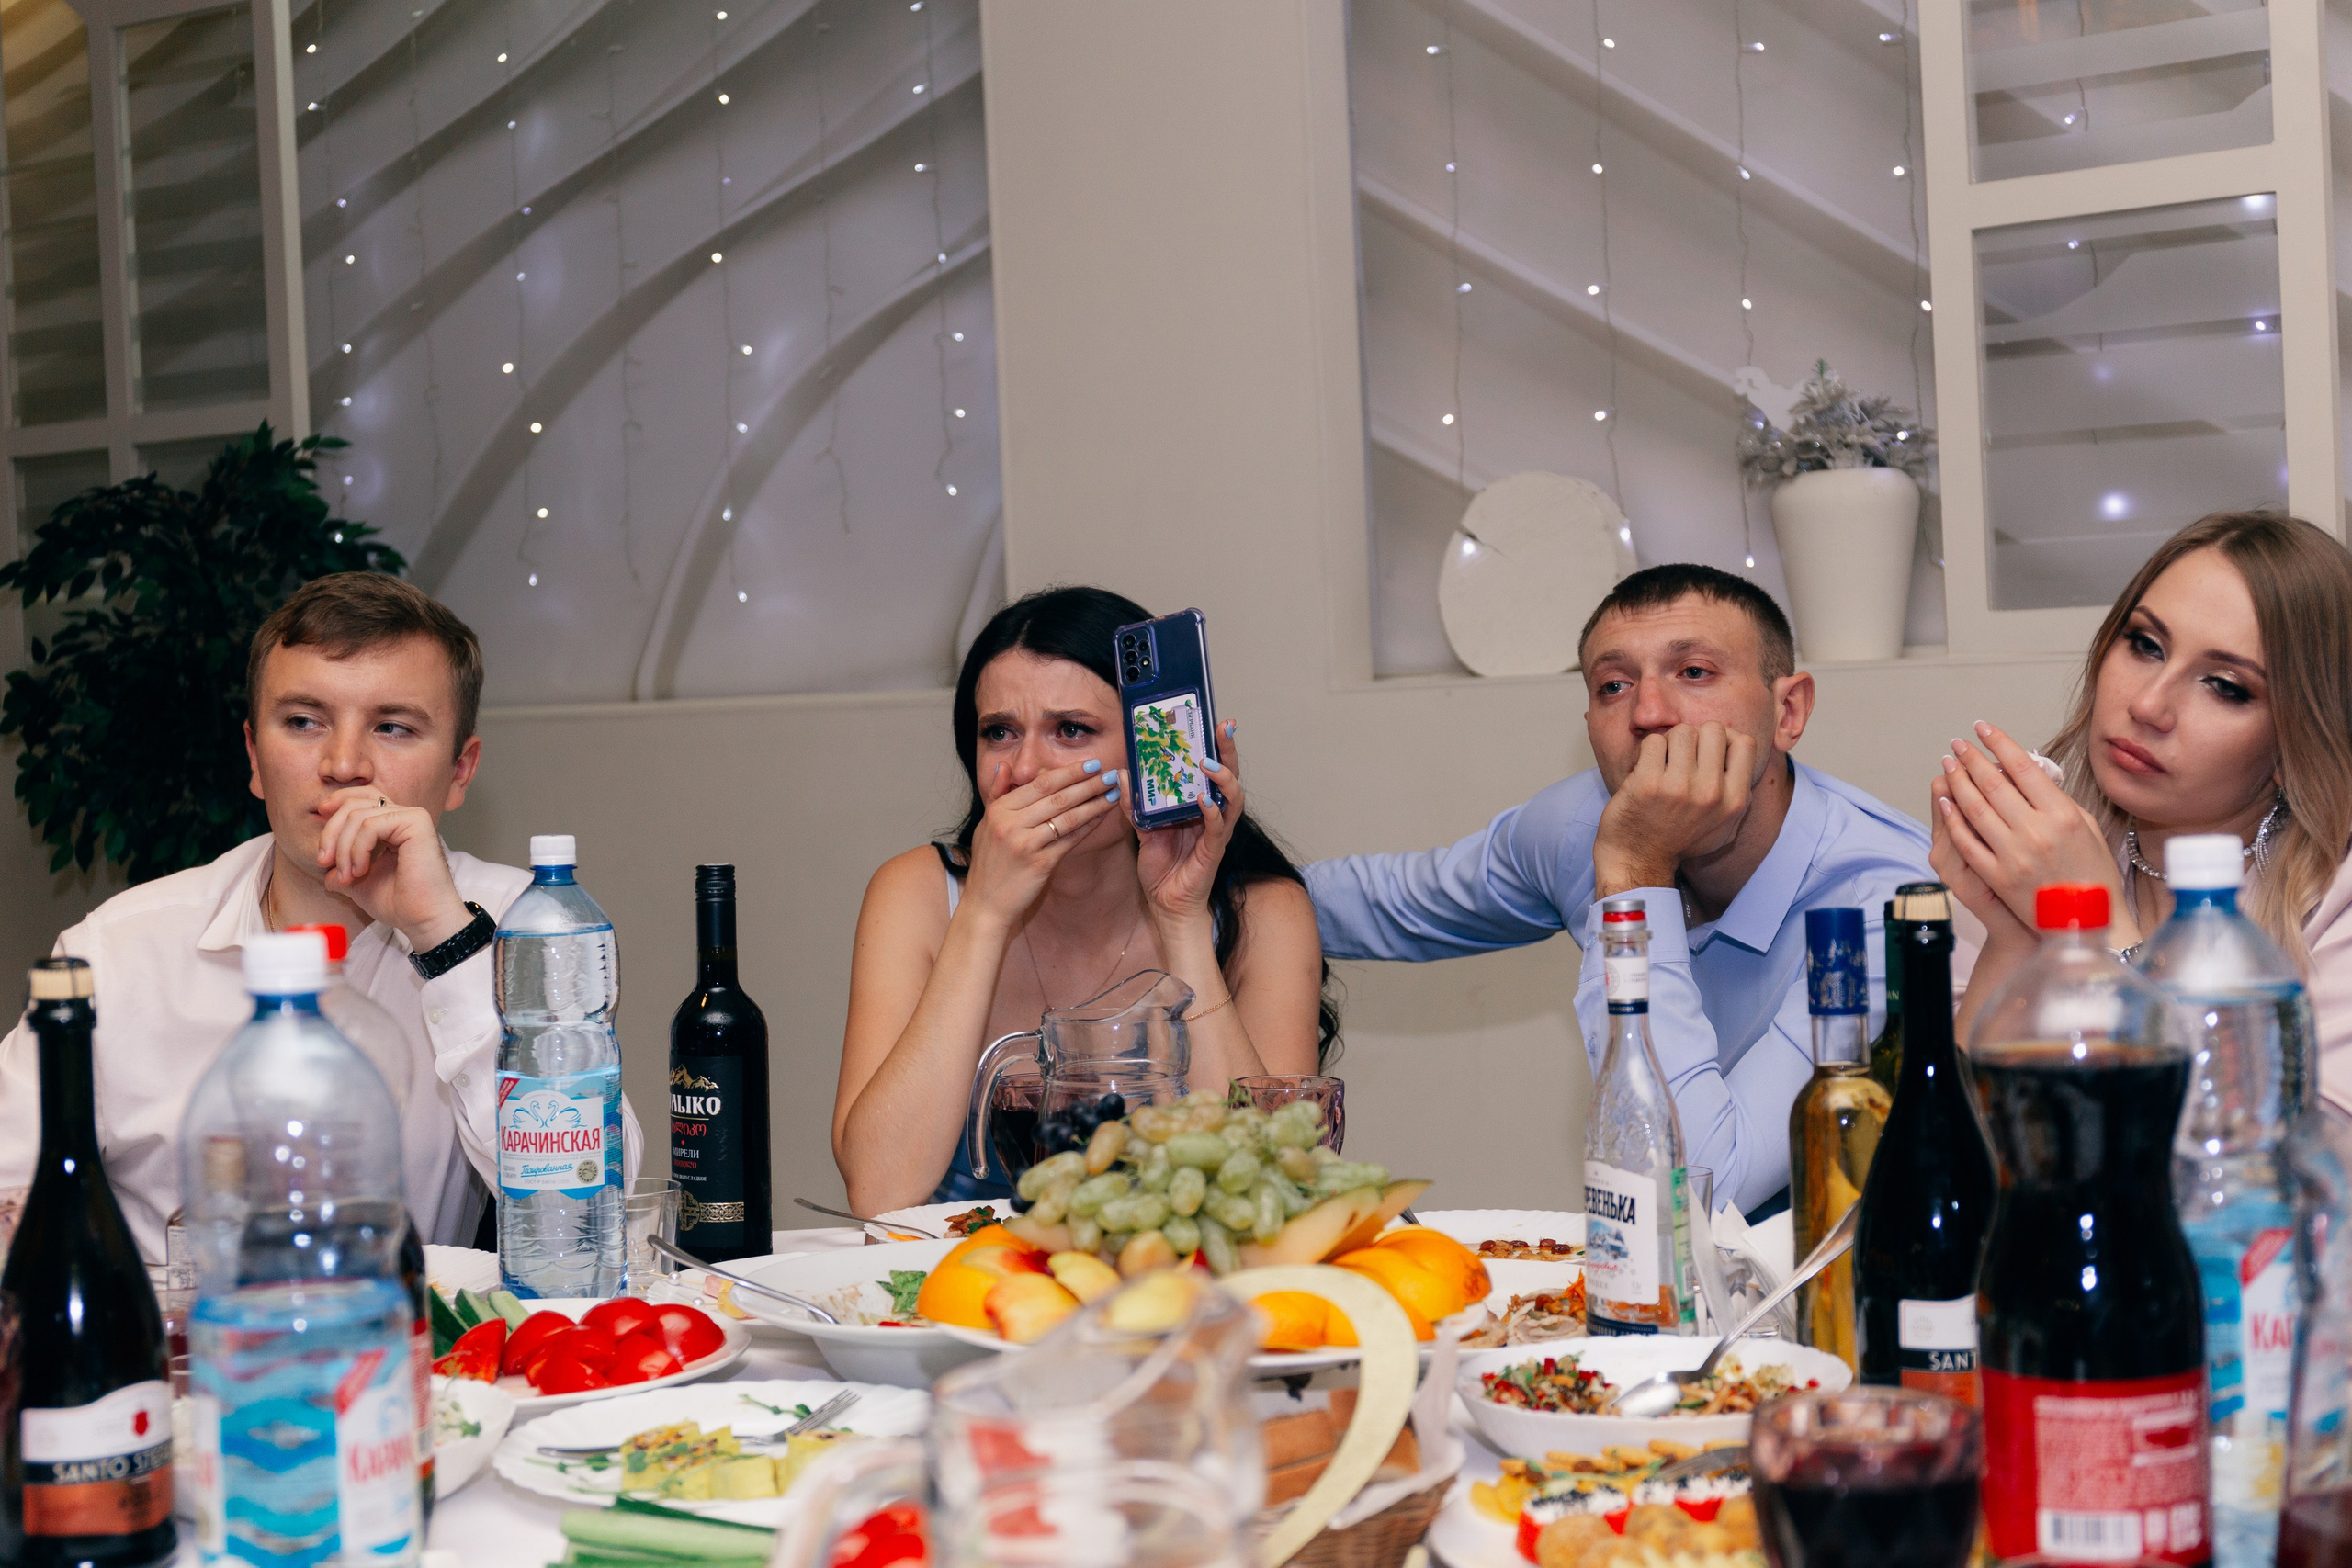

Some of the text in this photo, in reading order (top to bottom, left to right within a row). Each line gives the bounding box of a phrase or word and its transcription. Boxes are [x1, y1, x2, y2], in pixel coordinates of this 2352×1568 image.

[1146, 778, 1157, 807] МИР
[501, 1125, 601, 1154] КАРАЧИНСКАЯ
[1585, 1186, 1636, 1224] ЕВЕНЬКА
[52, 1455, 130, 1485] SANTO
